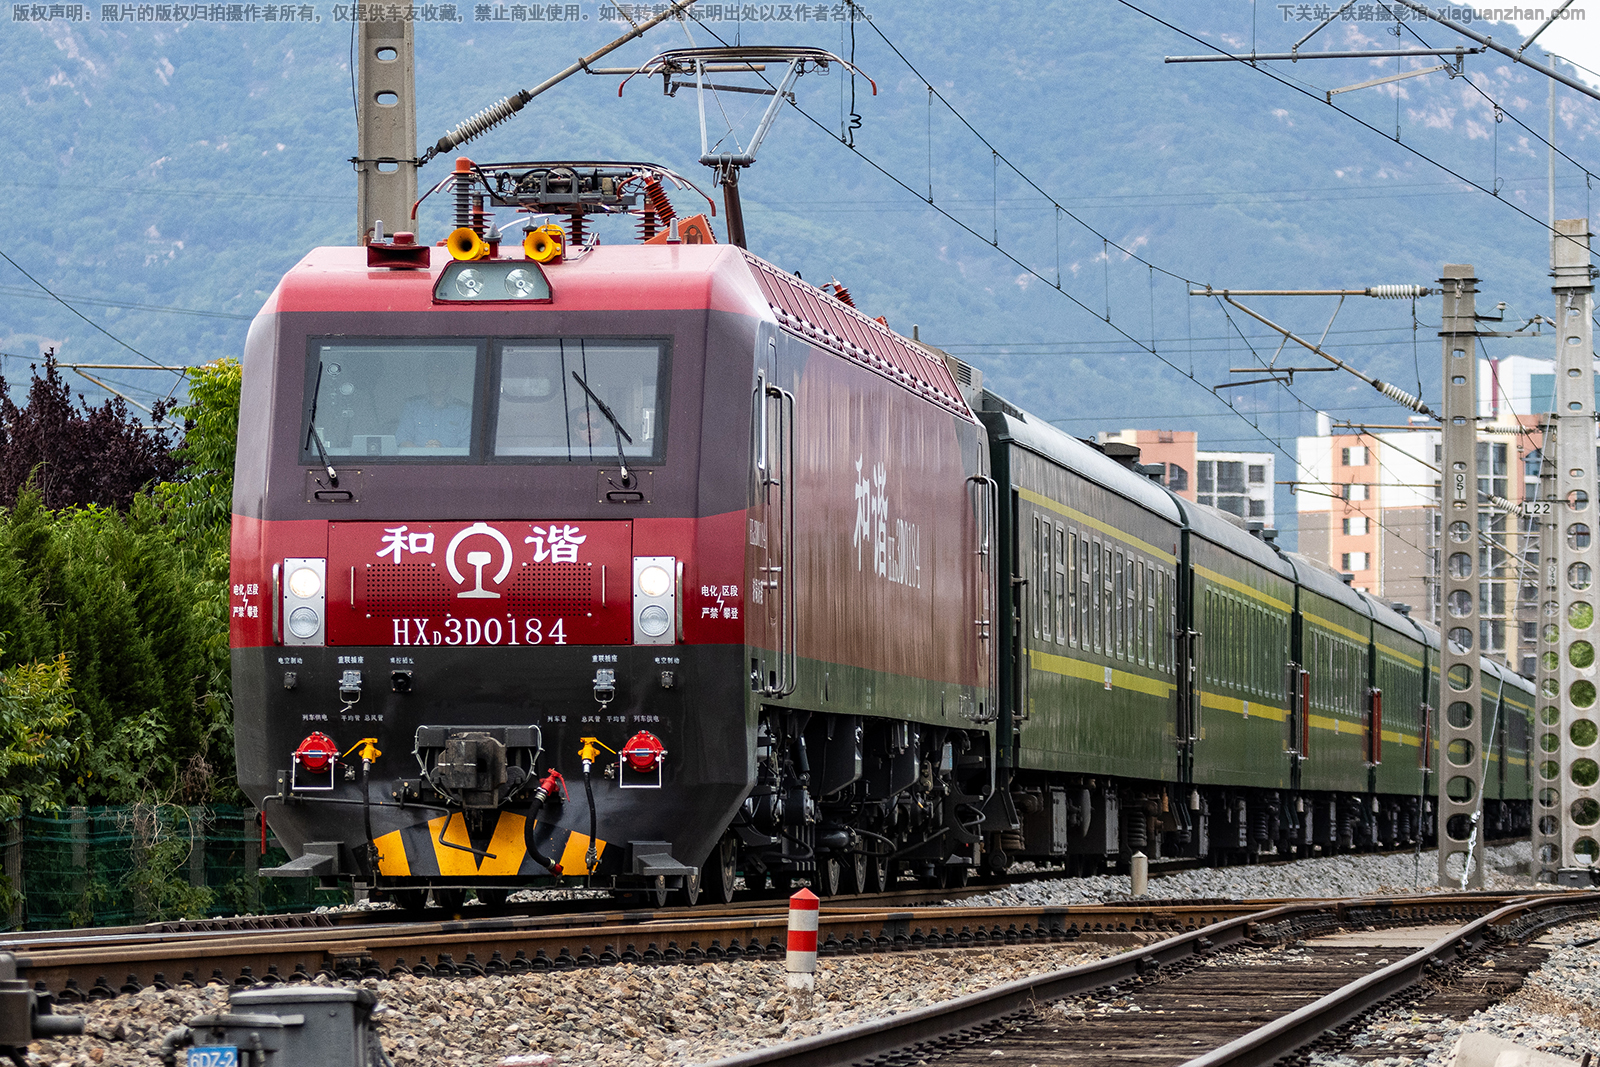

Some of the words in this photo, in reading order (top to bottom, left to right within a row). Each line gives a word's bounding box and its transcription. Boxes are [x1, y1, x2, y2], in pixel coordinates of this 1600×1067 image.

[1524, 503, 1551, 515] L22
[853, 452, 889, 579] 和谐
[376, 525, 435, 565] 和
[524, 524, 588, 564] 谐
[701, 585, 718, 597] 电化
[722, 585, 739, 597] 区段
[701, 607, 719, 619] 严禁
[723, 607, 739, 619] 攀登
[393, 618, 568, 646] HXD3D0184
[337, 655, 364, 664] 重联插座
[591, 654, 618, 663] 重联插座
[190, 1051, 235, 1067] 6DZ-2
